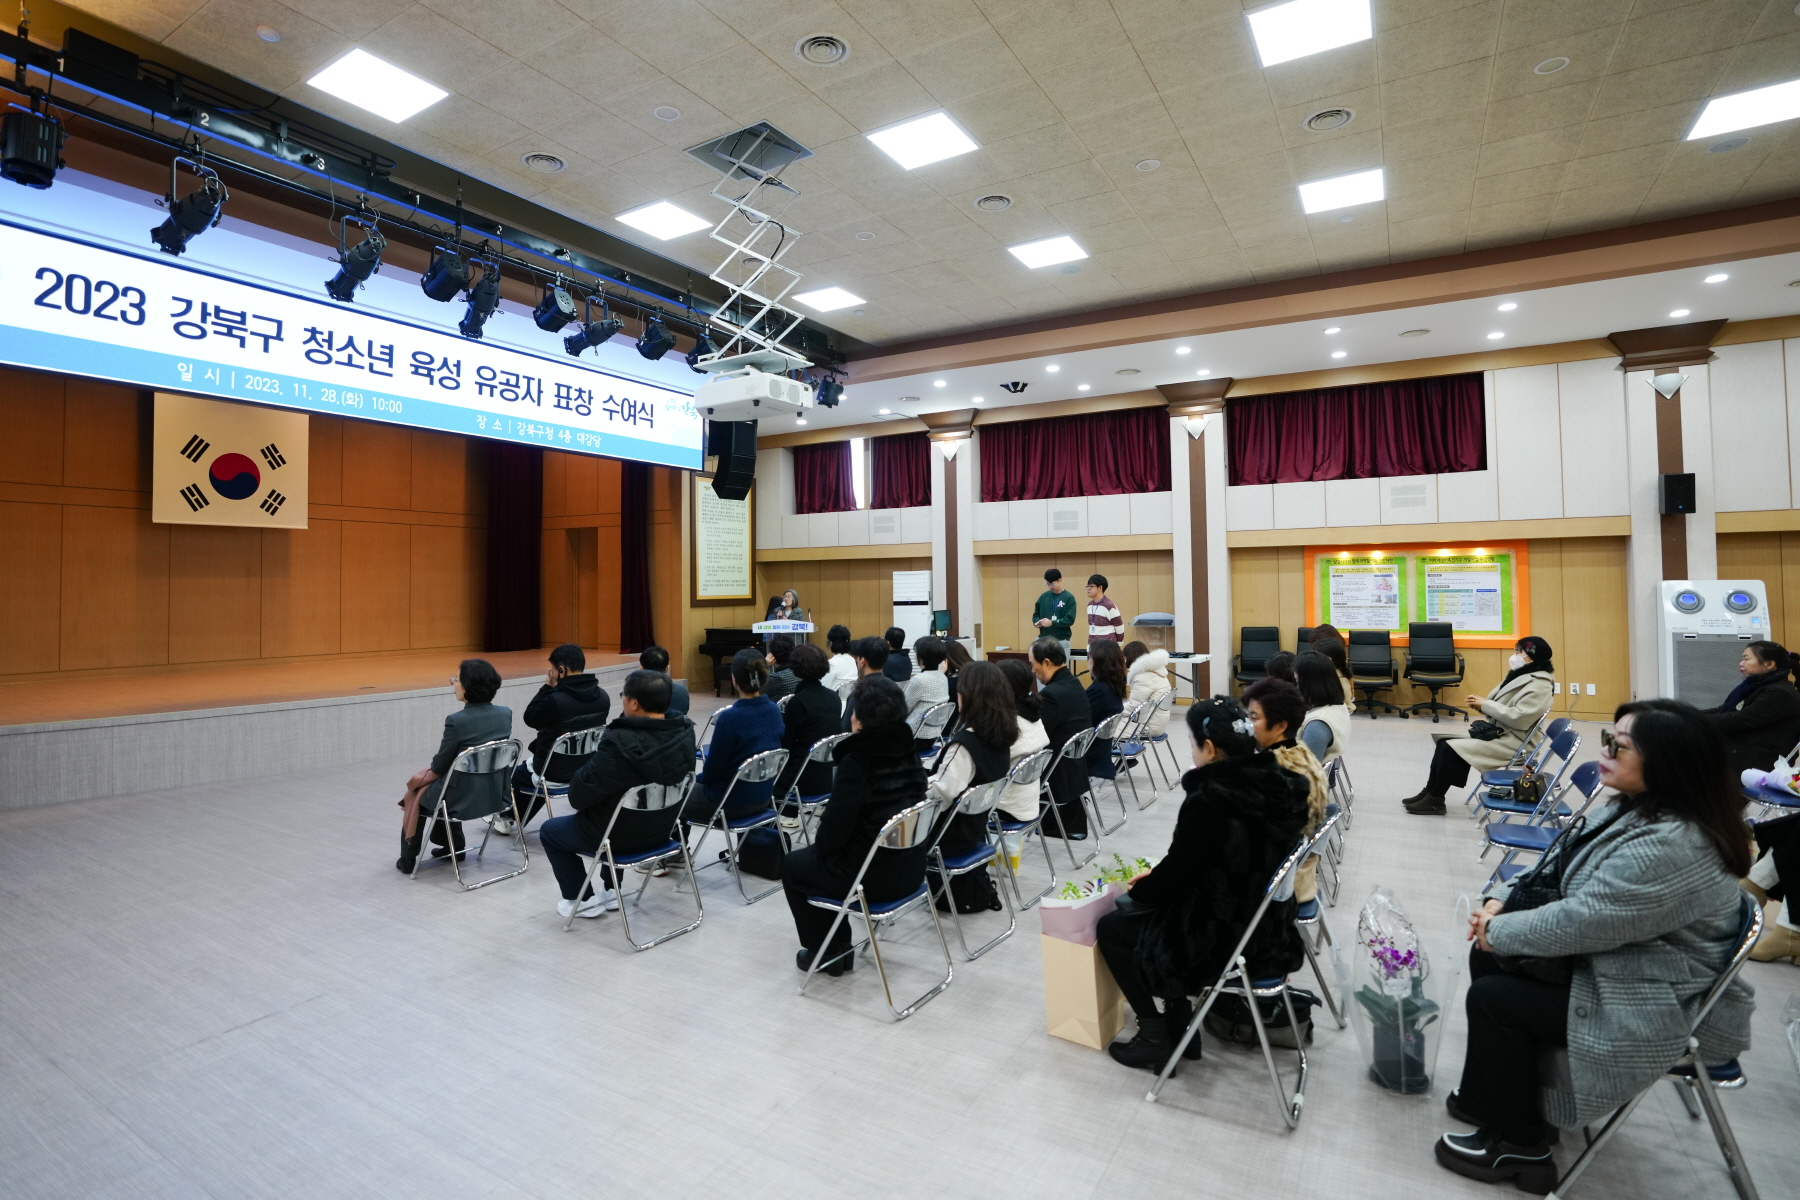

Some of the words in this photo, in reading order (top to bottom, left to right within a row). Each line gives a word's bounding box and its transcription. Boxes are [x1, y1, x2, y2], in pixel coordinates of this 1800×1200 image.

[57, 58, 65, 73] 1
[200, 112, 210, 127] 2
[34, 267, 147, 326] 2023
[170, 296, 284, 354] 강북구
[302, 326, 395, 378] 청소년
[409, 350, 462, 391] 육성
[474, 365, 544, 407] 유공자
[553, 382, 594, 417] 표창
[602, 394, 655, 429] 수여식
[177, 362, 194, 382] 일
[204, 367, 220, 386] 시
[244, 375, 284, 396] 2023.
[293, 383, 312, 400] 11.
[321, 388, 364, 409] 28.(화)
[371, 396, 403, 414] 10:00
[476, 414, 488, 430] 장
[493, 419, 503, 431] 소
[516, 421, 554, 441] 강북구청
[557, 429, 572, 444] 4층
[576, 431, 602, 448] 대강당
